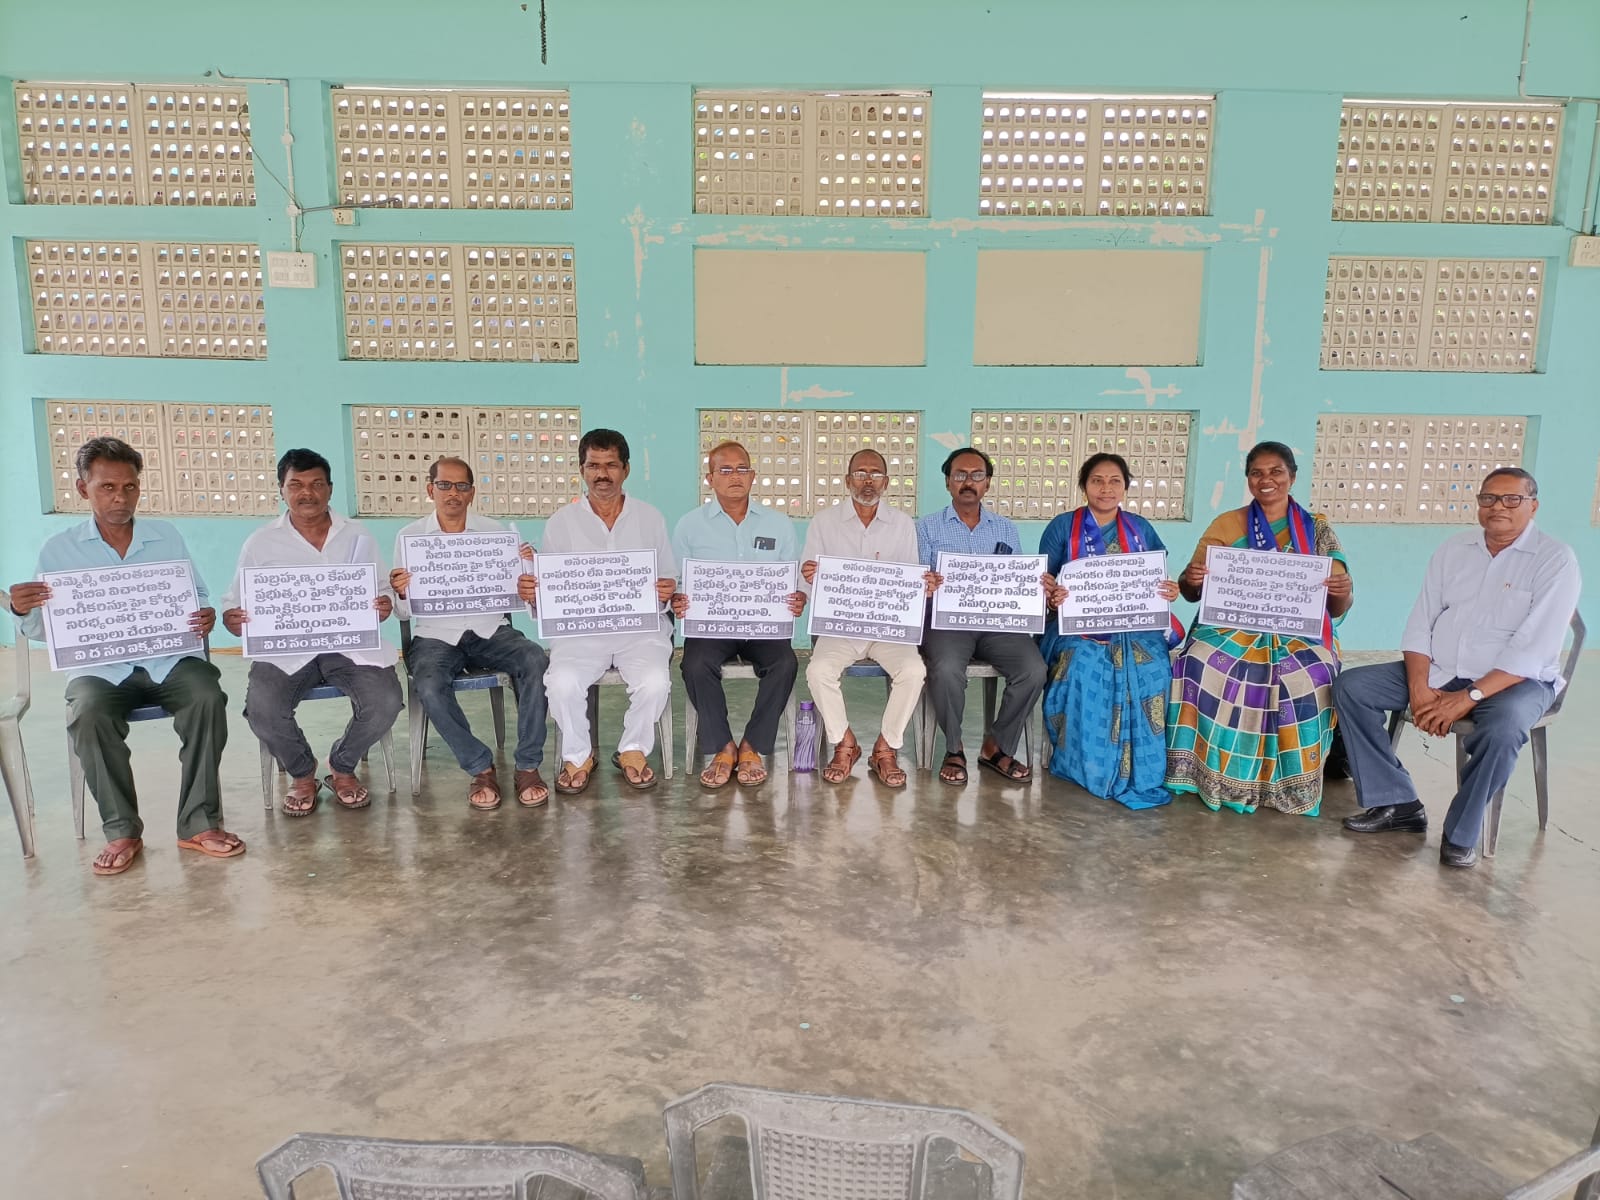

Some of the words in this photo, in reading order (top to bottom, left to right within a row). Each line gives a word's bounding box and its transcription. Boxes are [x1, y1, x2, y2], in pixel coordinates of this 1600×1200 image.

[448, 536, 515, 546] అనంతబాబుపై
[426, 550, 451, 559] సిబిఐ
[454, 548, 503, 558] విచారణకు
[470, 562, 483, 572] హై
[485, 557, 519, 572] కోర్టులో
[564, 555, 630, 566] అనంతబాబుపై
[1008, 559, 1039, 570] కేసులో
[1085, 557, 1145, 567] అనంతబాబుపై
[1252, 555, 1323, 572] అనంతబాబుపై
[100, 566, 186, 582] అనంతబాబుపై
[328, 568, 366, 581] కేసులో
[542, 570, 584, 579] దాపరికం
[587, 568, 603, 577] లేని
[606, 566, 651, 576] విచారణకు
[756, 566, 789, 577] కేసులో
[843, 563, 903, 578] అనంతబాబుపై
[1064, 571, 1103, 579] దాపరికం
[1106, 569, 1120, 578] లేని
[1123, 567, 1162, 577] విచారణకు
[1228, 563, 1253, 575] సిబిఐ
[1256, 568, 1307, 580] విచారణకు
[604, 577, 647, 591] హైకోర్టులో
[821, 573, 859, 583] దాపరికం
[862, 576, 877, 585] లేని
[879, 578, 922, 589] విచారణకు
[991, 572, 1037, 587] హైకోర్టుకు
[72, 588, 105, 599] సిబిఐ
[109, 581, 170, 595] విచారణకు
[311, 584, 366, 600] హైకోర్టుకు
[428, 588, 463, 596] దాఖలు
[467, 585, 505, 594] చేయాలి.
[740, 580, 787, 594] హైకోర్టుకు
[1005, 586, 1037, 596] నివేదిక
[1270, 580, 1283, 591] హై
[1286, 581, 1322, 594] కోర్టులో
[131, 598, 146, 611] హై
[150, 590, 192, 608] కోర్టులో
[875, 589, 917, 602] హైకోర్టులో
[329, 600, 368, 611] నివేదిక
[435, 602, 444, 611] ద
[447, 601, 464, 610] సం
[563, 606, 595, 615] దాఖలు
[598, 604, 635, 613] చేయాలి.
[959, 599, 1021, 612] సమర్పించాలి.
[1083, 606, 1113, 614] దాఖలు
[1116, 603, 1148, 612] చేయాలి.
[1224, 600, 1258, 610] దాఖలు
[1261, 603, 1301, 615] చేయాలి.
[708, 607, 771, 620] సమర్పించాలి.
[834, 610, 864, 619] దాఖలు
[867, 611, 901, 623] చేయాలి.
[1228, 613, 1237, 621] ద
[1239, 614, 1256, 624] సం
[275, 617, 350, 633] సమర్పించాలి.
[568, 621, 576, 630] ద
[579, 620, 595, 630] సం
[835, 622, 843, 631] ద
[846, 624, 861, 632] సం
[959, 616, 966, 624] ద
[969, 617, 984, 625] సం
[1086, 619, 1094, 627] ద
[1097, 618, 1112, 627] సం
[79, 631, 124, 643] దాఖలు
[128, 623, 177, 637] చేయాలి.
[708, 624, 716, 632] ద
[719, 624, 734, 632] సం
[277, 640, 286, 648] ద
[290, 638, 308, 648] సం
[89, 647, 100, 658] ద
[104, 645, 125, 657] సం
